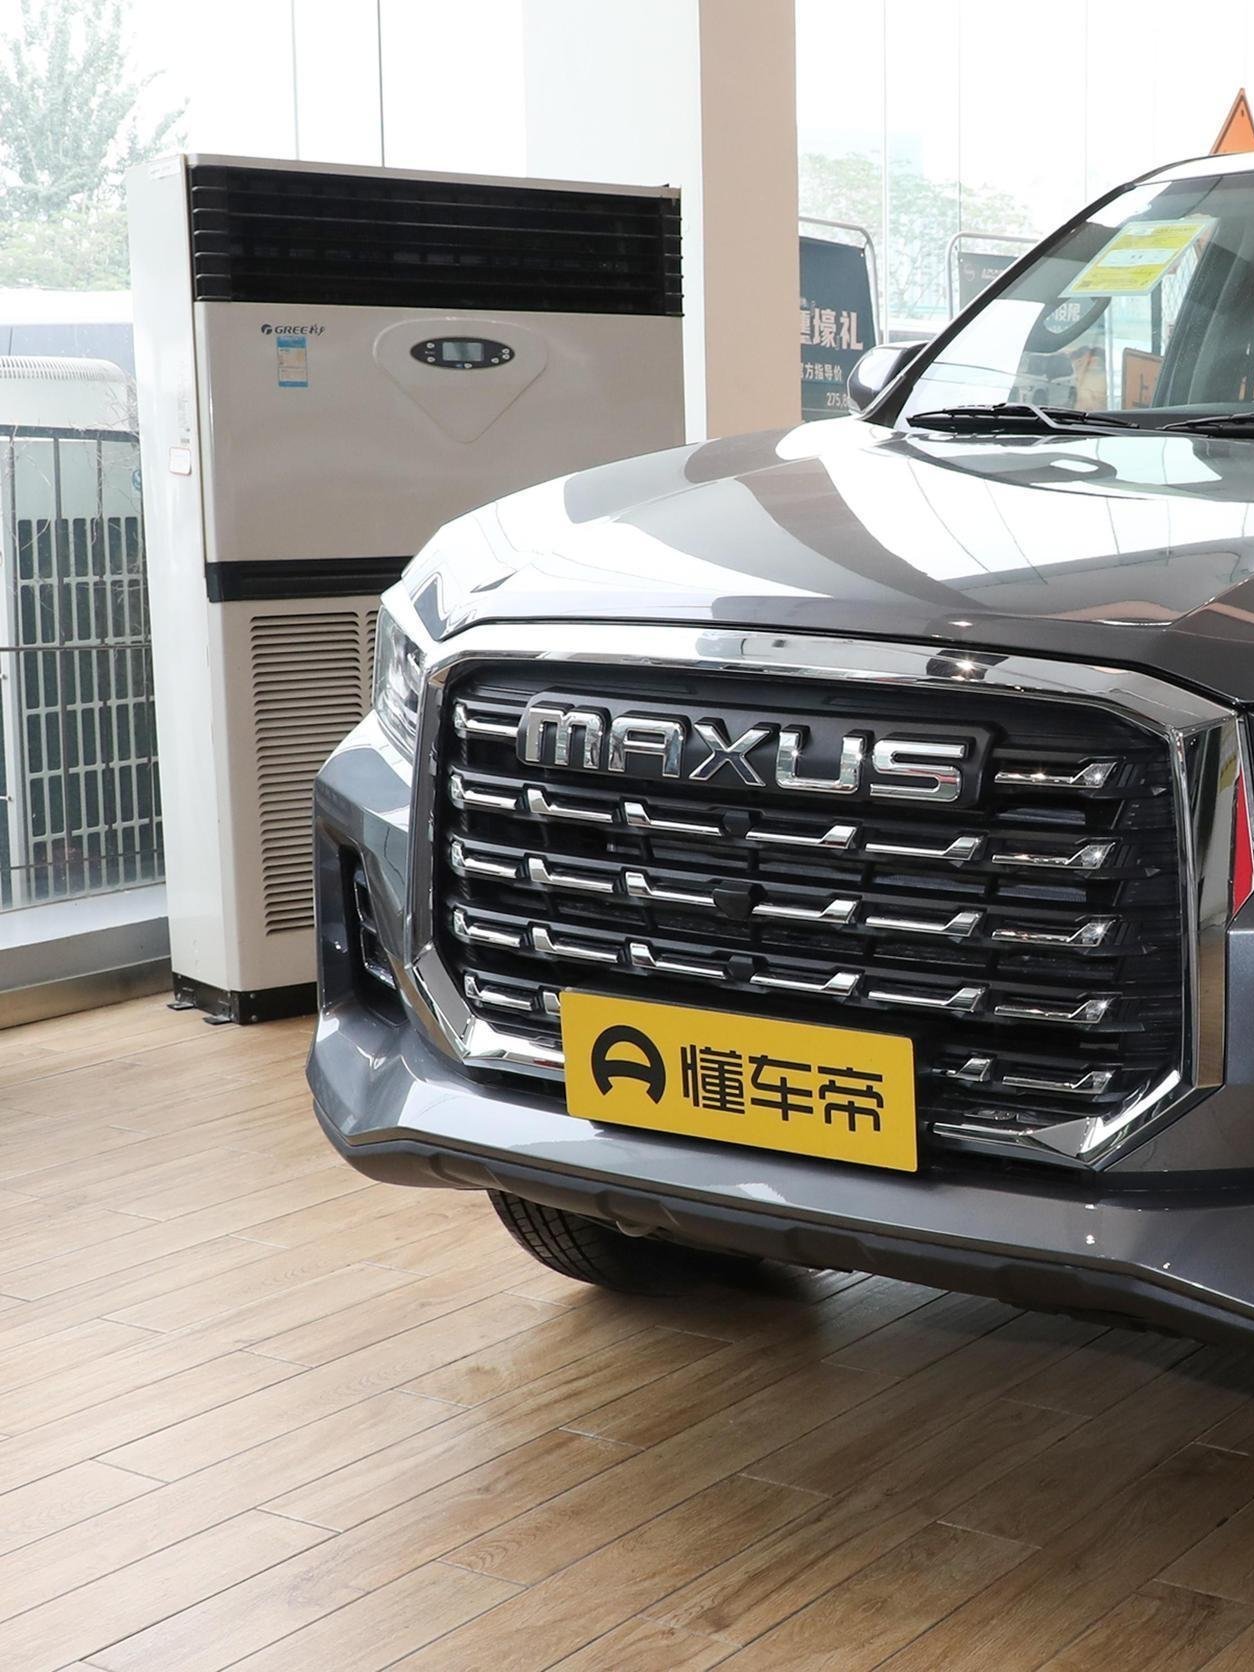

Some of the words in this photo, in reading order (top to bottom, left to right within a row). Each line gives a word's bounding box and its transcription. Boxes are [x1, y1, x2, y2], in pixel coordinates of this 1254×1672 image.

[523, 703, 971, 801] MAXUS
[679, 1043, 885, 1133] 懂车帝
